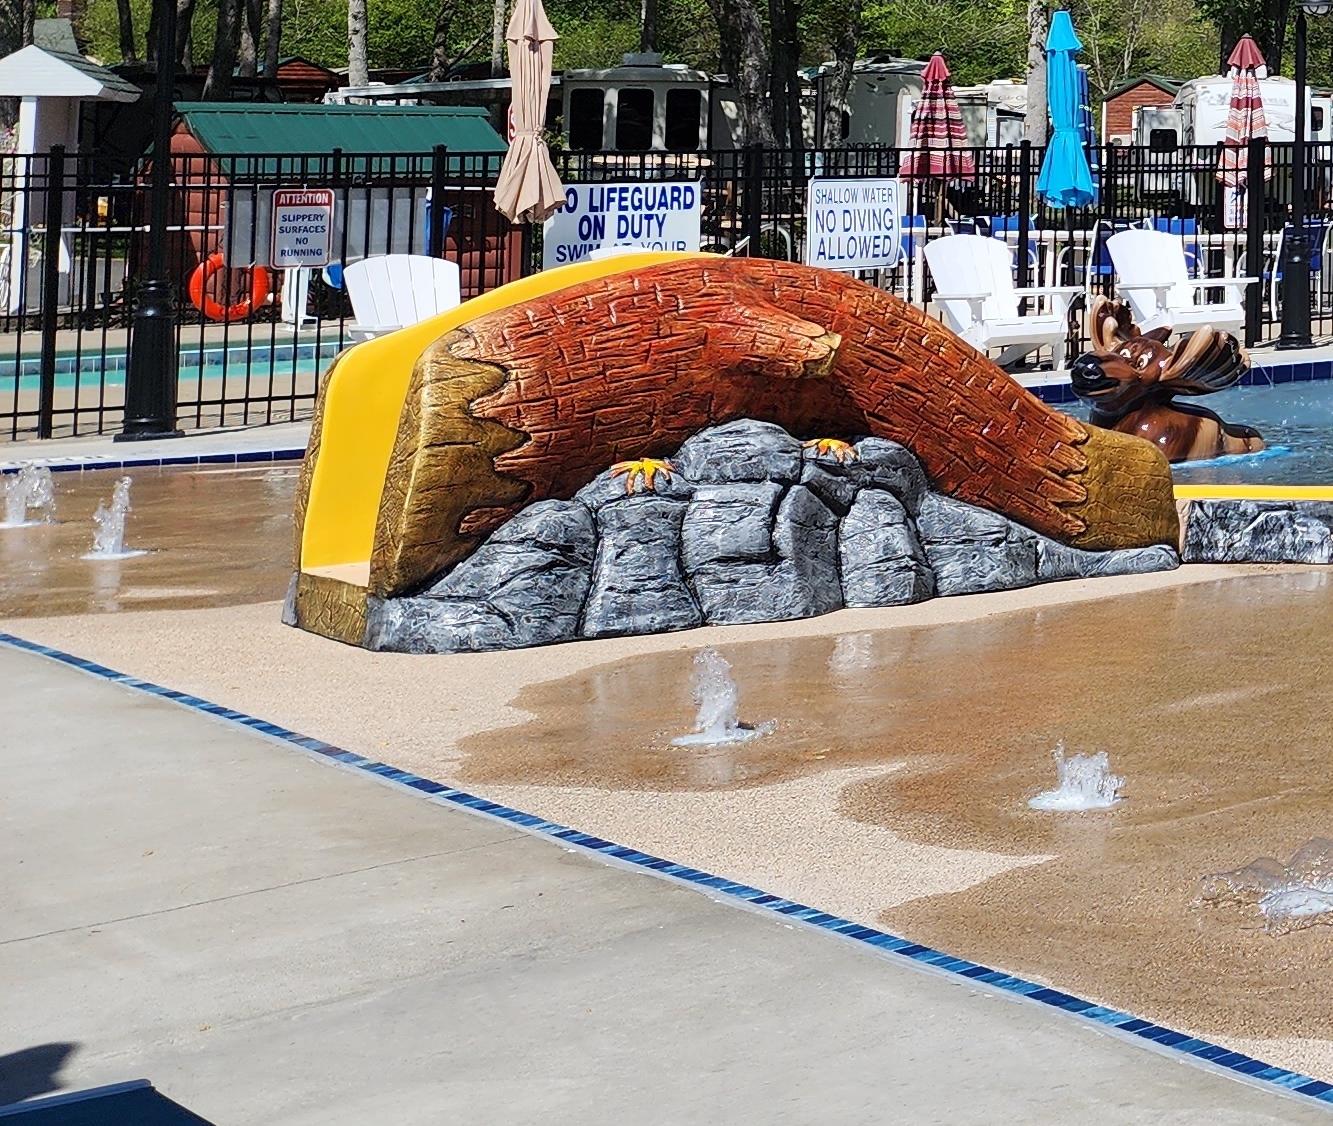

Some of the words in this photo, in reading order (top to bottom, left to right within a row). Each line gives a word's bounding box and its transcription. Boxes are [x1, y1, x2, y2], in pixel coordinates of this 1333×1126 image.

[279, 193, 329, 204] ATTENTION
[555, 187, 579, 214] O
[589, 186, 695, 212] LIFEGUARD
[815, 188, 859, 204] SHALLOW
[861, 187, 893, 203] WATER
[281, 214, 324, 222] SLIPPERY
[816, 210, 836, 233] NO
[843, 208, 893, 232] DIVING
[278, 226, 326, 234] SURFACES
[579, 215, 605, 241] ON
[617, 213, 667, 240] DUTY
[295, 237, 309, 245] NO
[817, 235, 892, 261] ALLOWED
[281, 248, 322, 257] RUNNING
